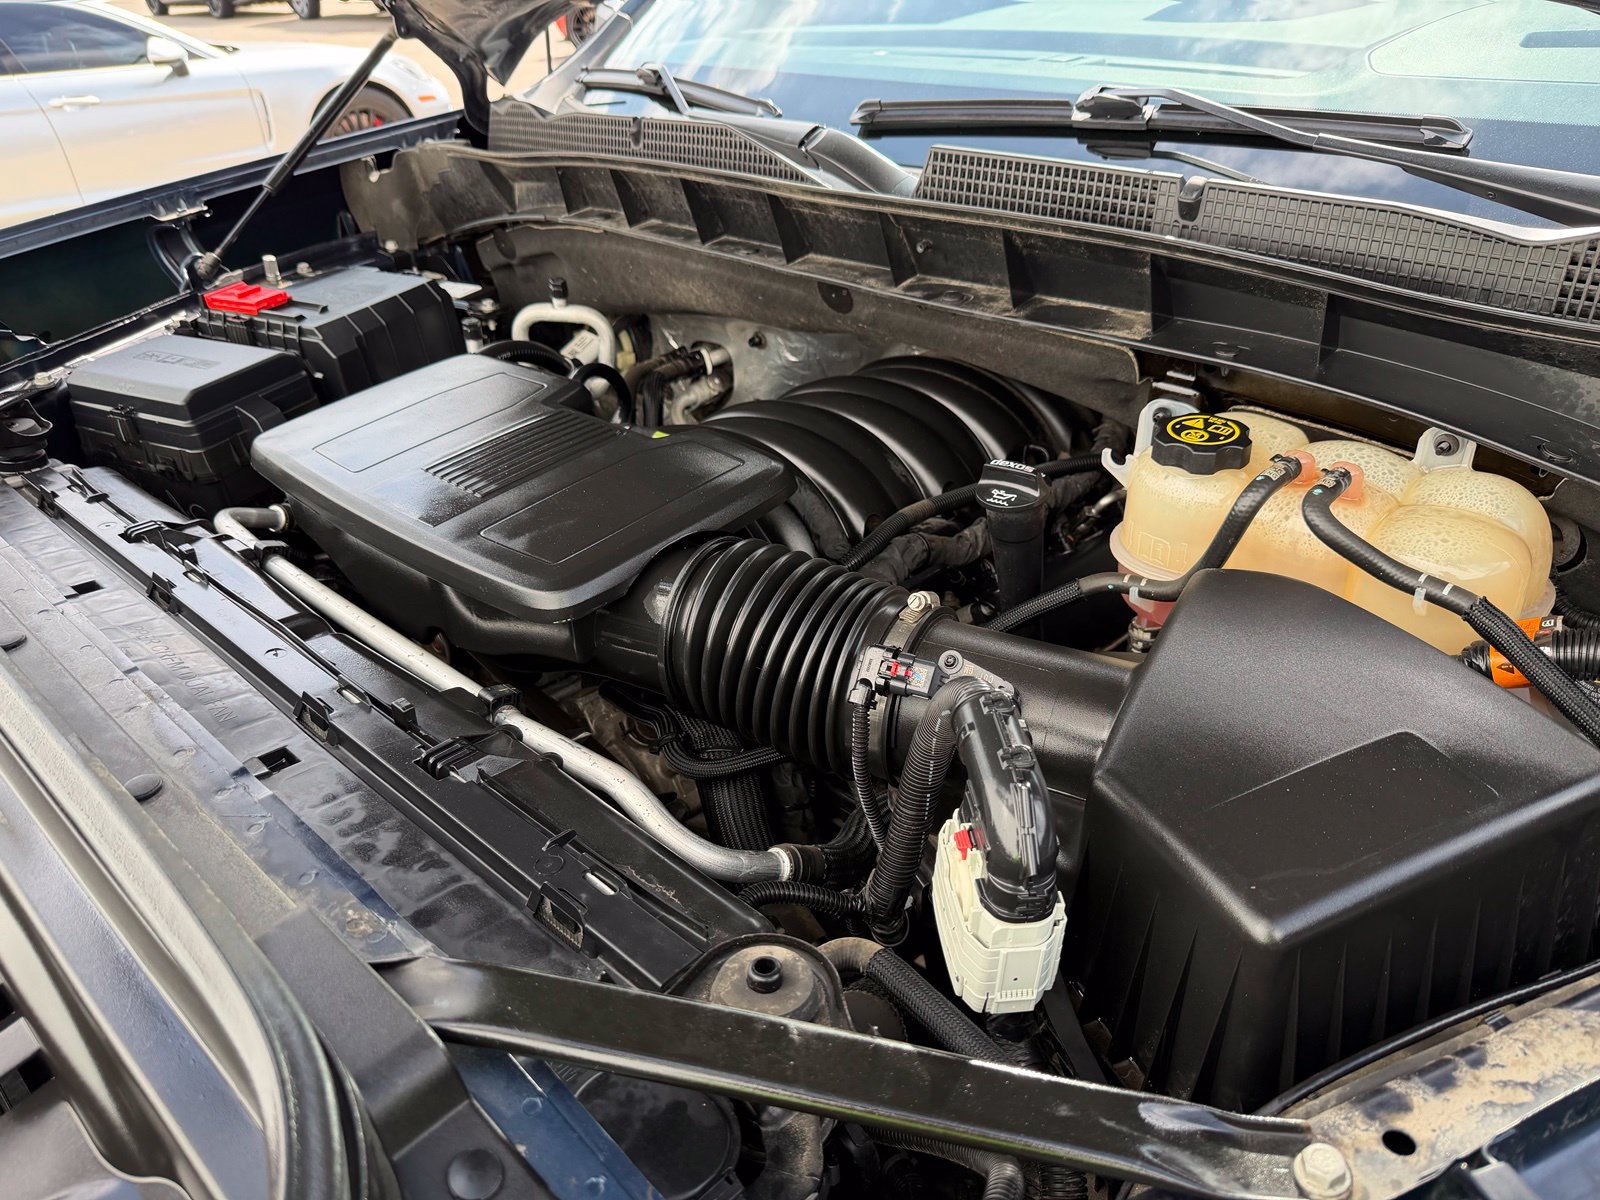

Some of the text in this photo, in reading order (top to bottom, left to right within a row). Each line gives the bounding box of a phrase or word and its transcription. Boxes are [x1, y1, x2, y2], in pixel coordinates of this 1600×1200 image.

[989, 459, 1036, 473] dexos
[176, 671, 215, 698] DUAL
[203, 699, 239, 723] FAN
